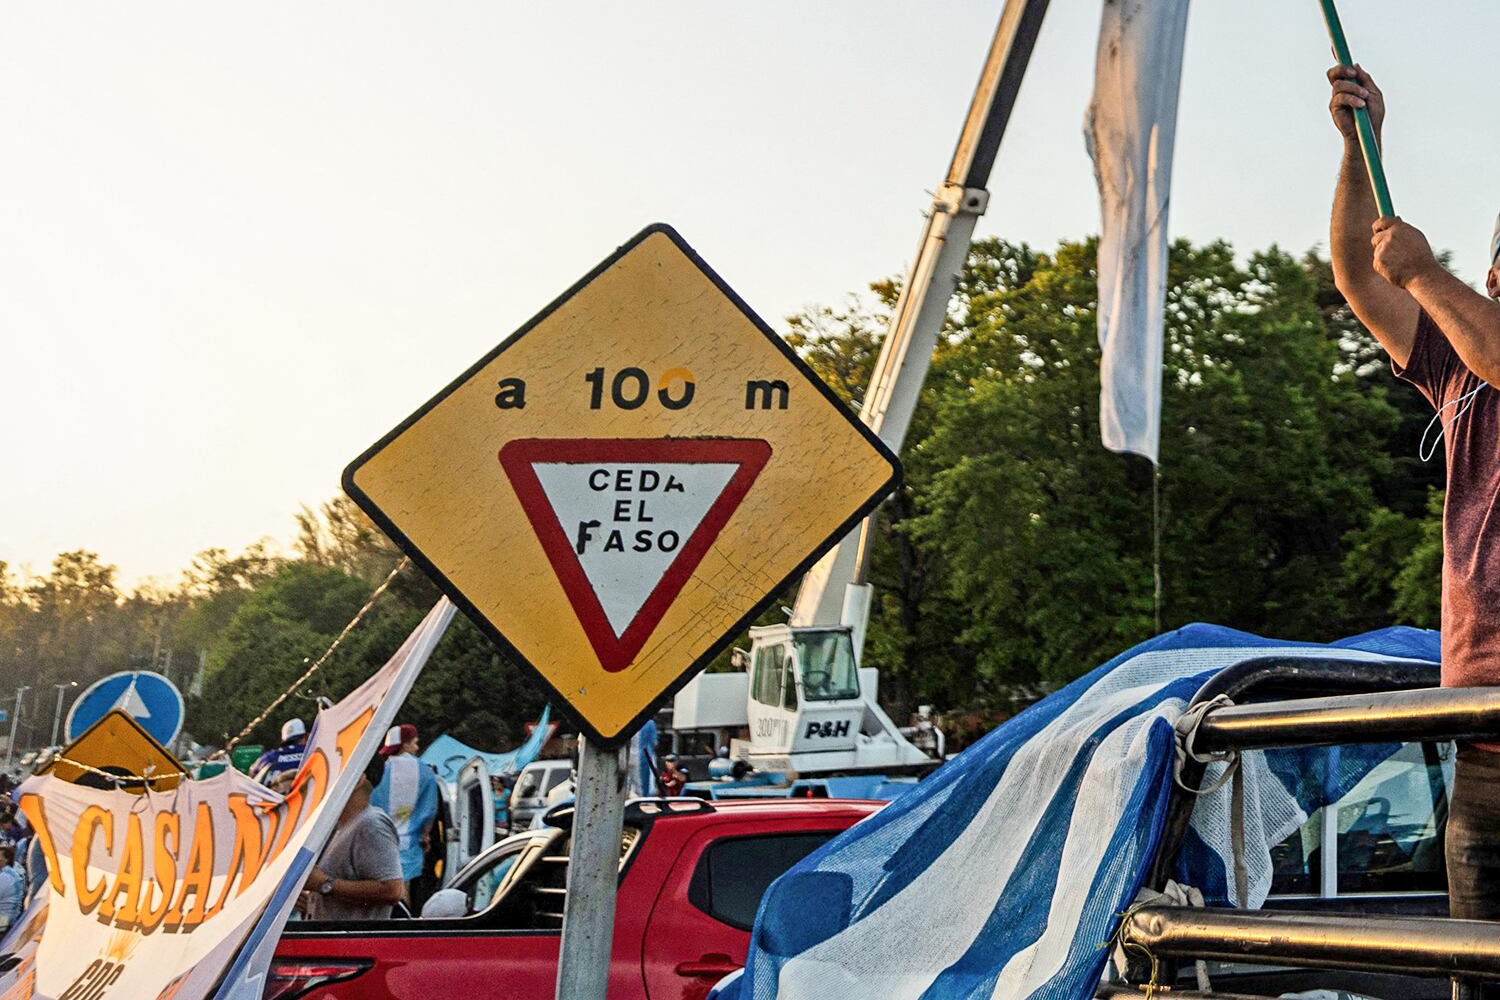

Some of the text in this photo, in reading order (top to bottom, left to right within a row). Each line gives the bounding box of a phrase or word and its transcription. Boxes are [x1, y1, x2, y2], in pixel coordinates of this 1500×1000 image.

[495, 367, 790, 410] a 100 m
[588, 469, 686, 493] CEDA
[613, 499, 654, 522] EL
[804, 720, 851, 739] P&H
